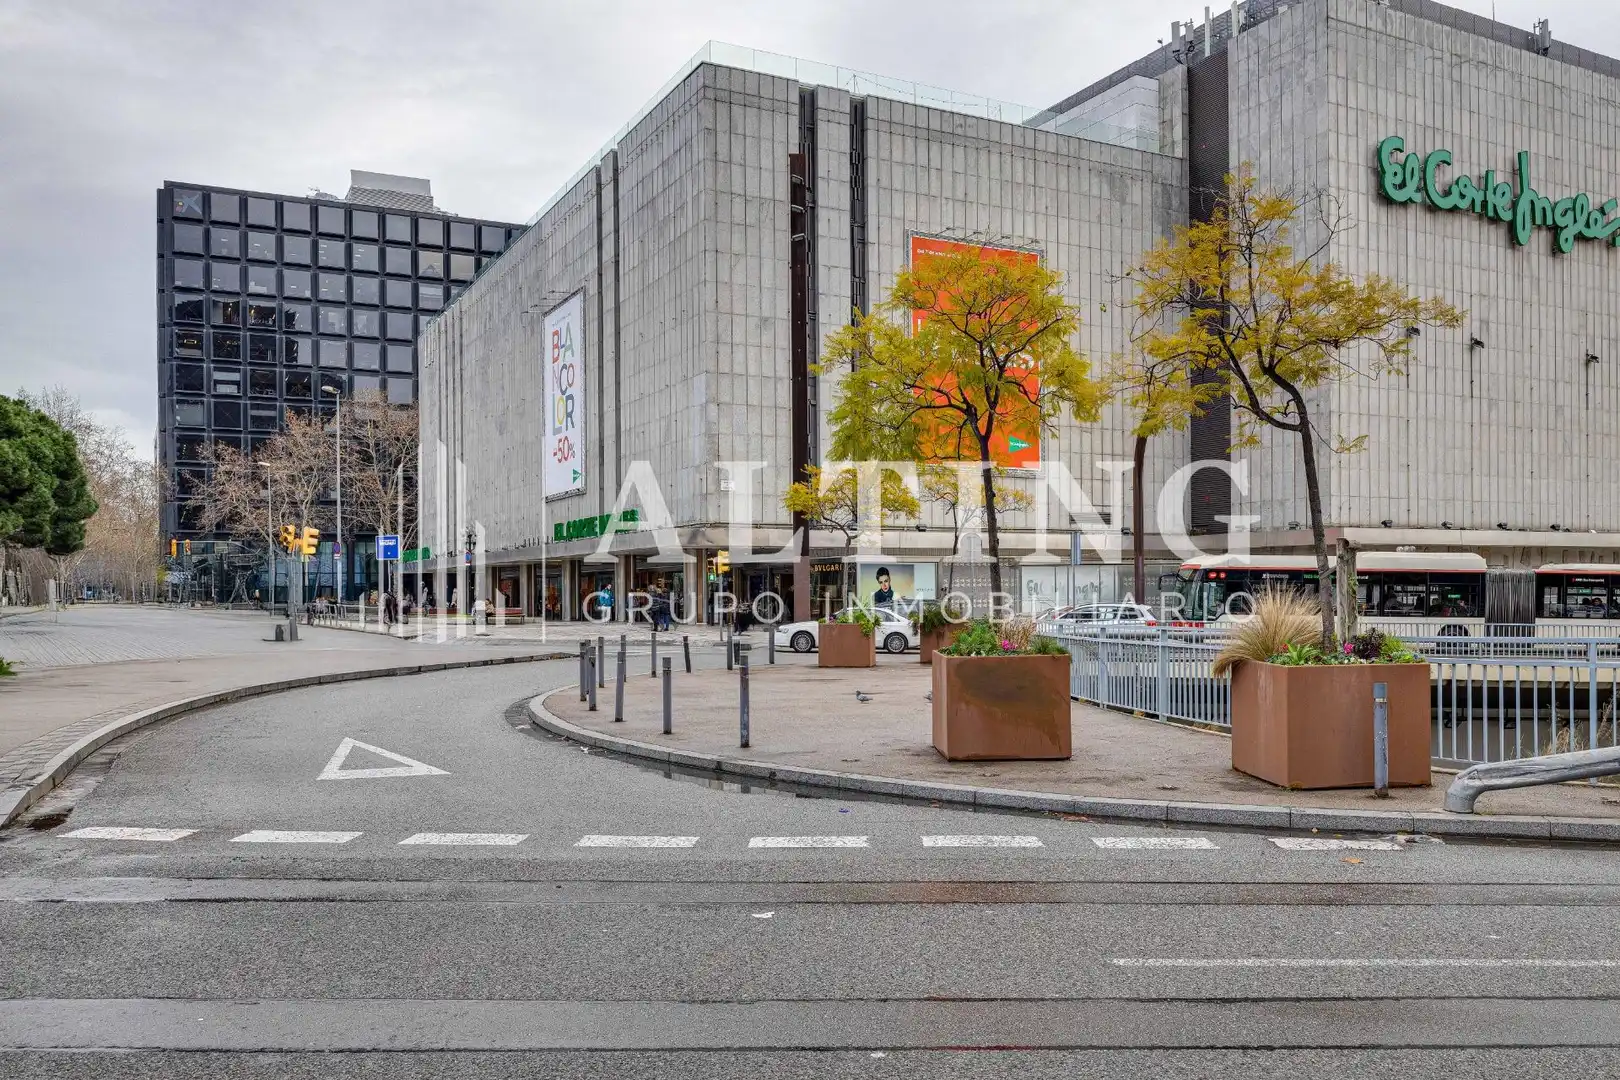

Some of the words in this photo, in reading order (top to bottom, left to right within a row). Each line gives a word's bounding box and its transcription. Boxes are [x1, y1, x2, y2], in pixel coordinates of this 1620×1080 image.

[1377, 135, 1421, 204] El
[1423, 148, 1513, 222] Corte
[553, 436, 576, 463] -50%
